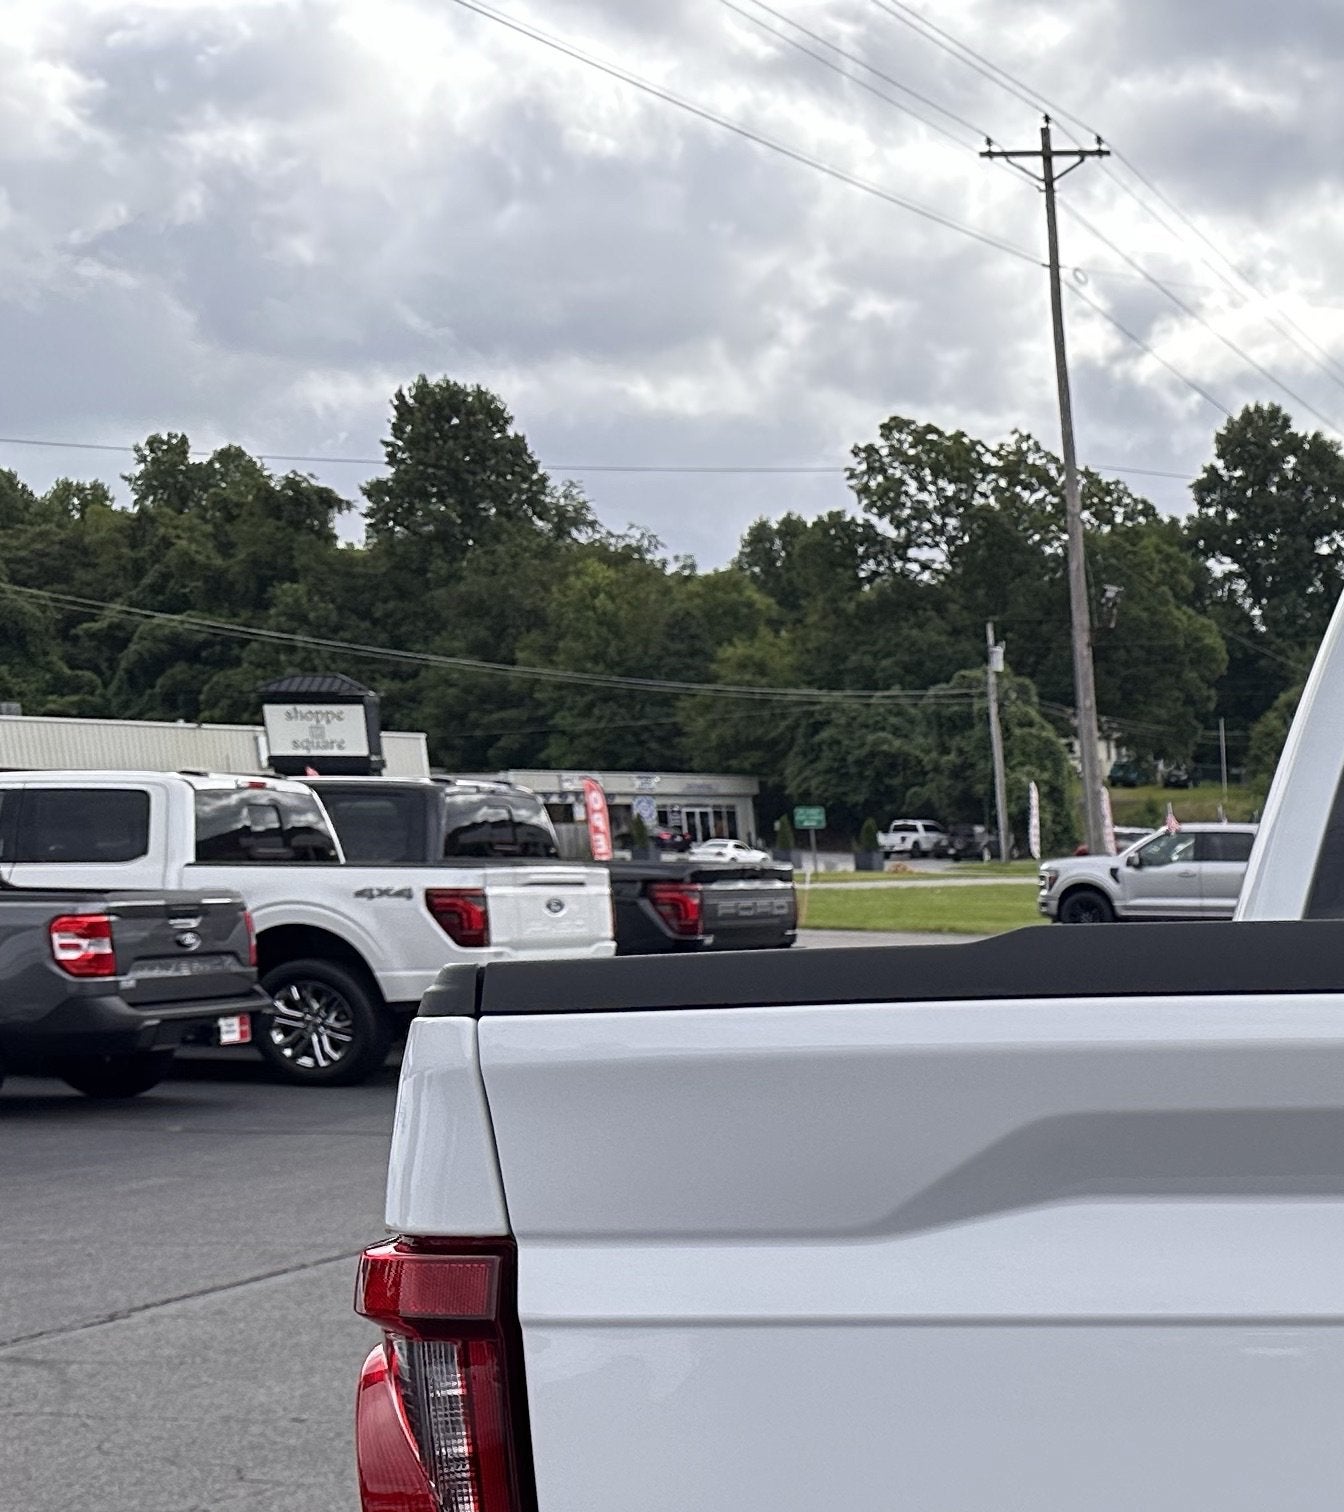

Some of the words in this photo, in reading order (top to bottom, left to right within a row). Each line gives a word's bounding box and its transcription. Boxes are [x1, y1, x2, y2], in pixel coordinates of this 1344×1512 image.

[284, 706, 344, 725] shoppe
[292, 738, 345, 753] square
[588, 790, 610, 856] OPE
